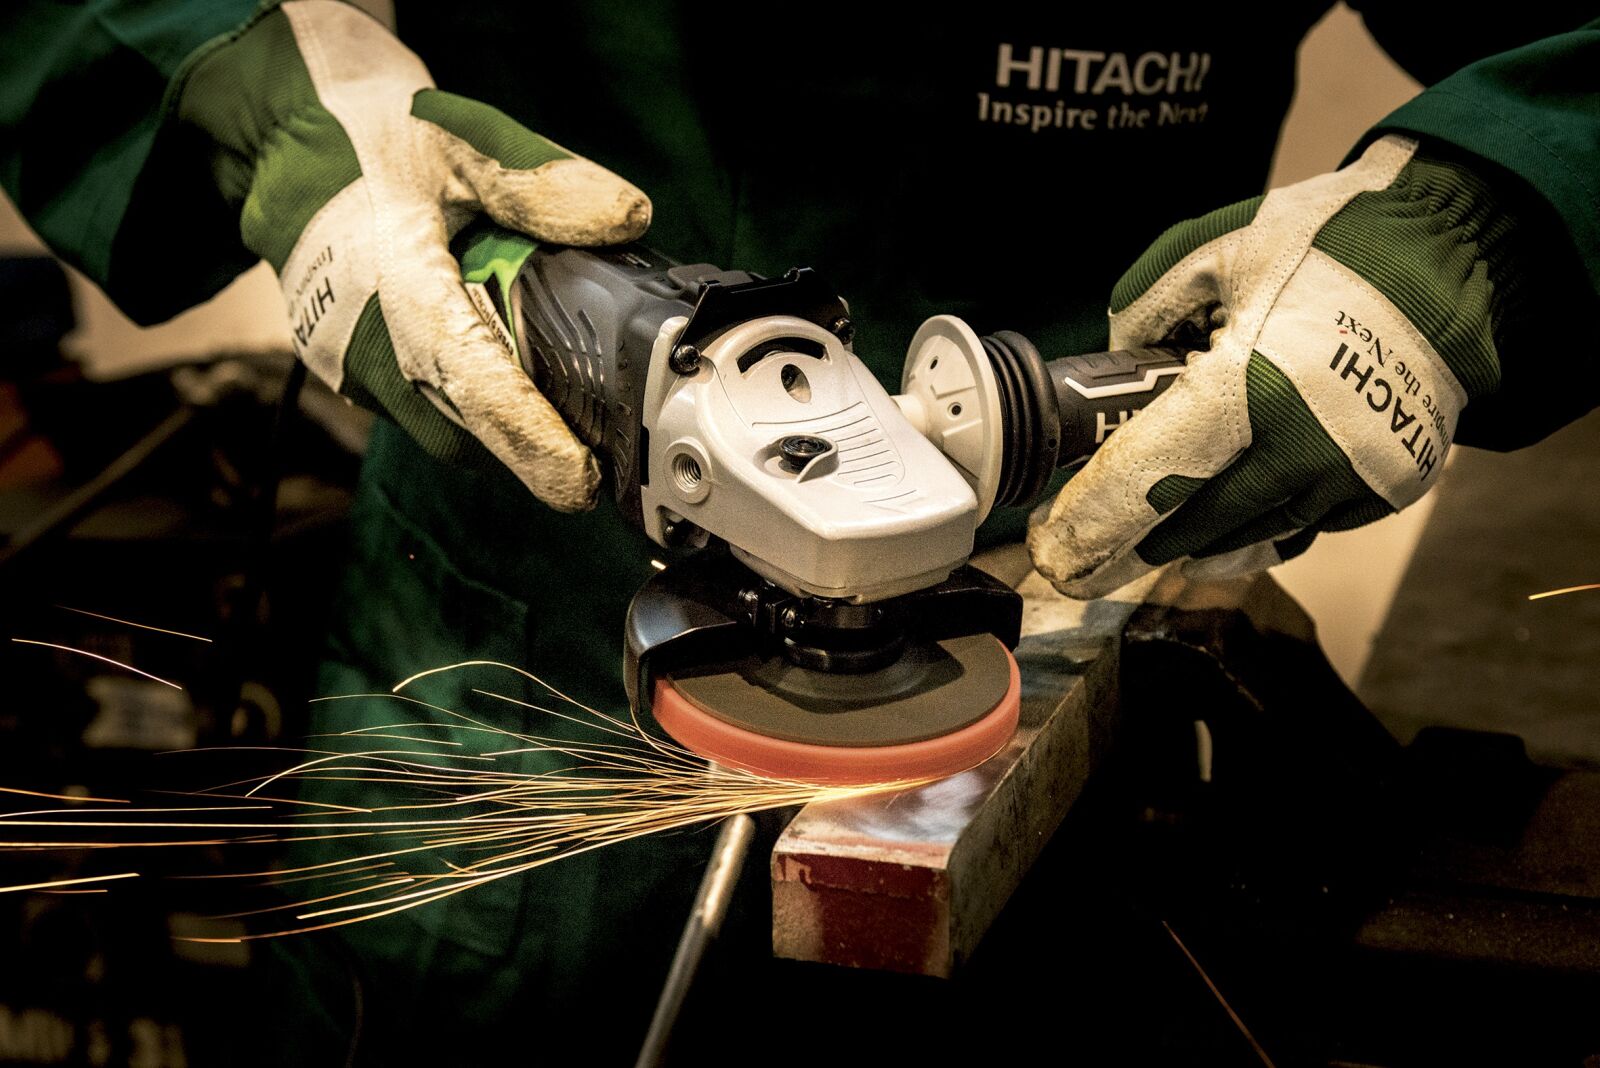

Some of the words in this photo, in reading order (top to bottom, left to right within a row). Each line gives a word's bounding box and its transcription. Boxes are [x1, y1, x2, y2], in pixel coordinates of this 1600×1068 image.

[996, 43, 1211, 95] HITACHI
[977, 92, 1099, 133] Inspire
[1106, 101, 1150, 130] the
[1334, 310, 1394, 368] Next
[1394, 361, 1421, 396] the
[1329, 342, 1437, 481] HITACHI
